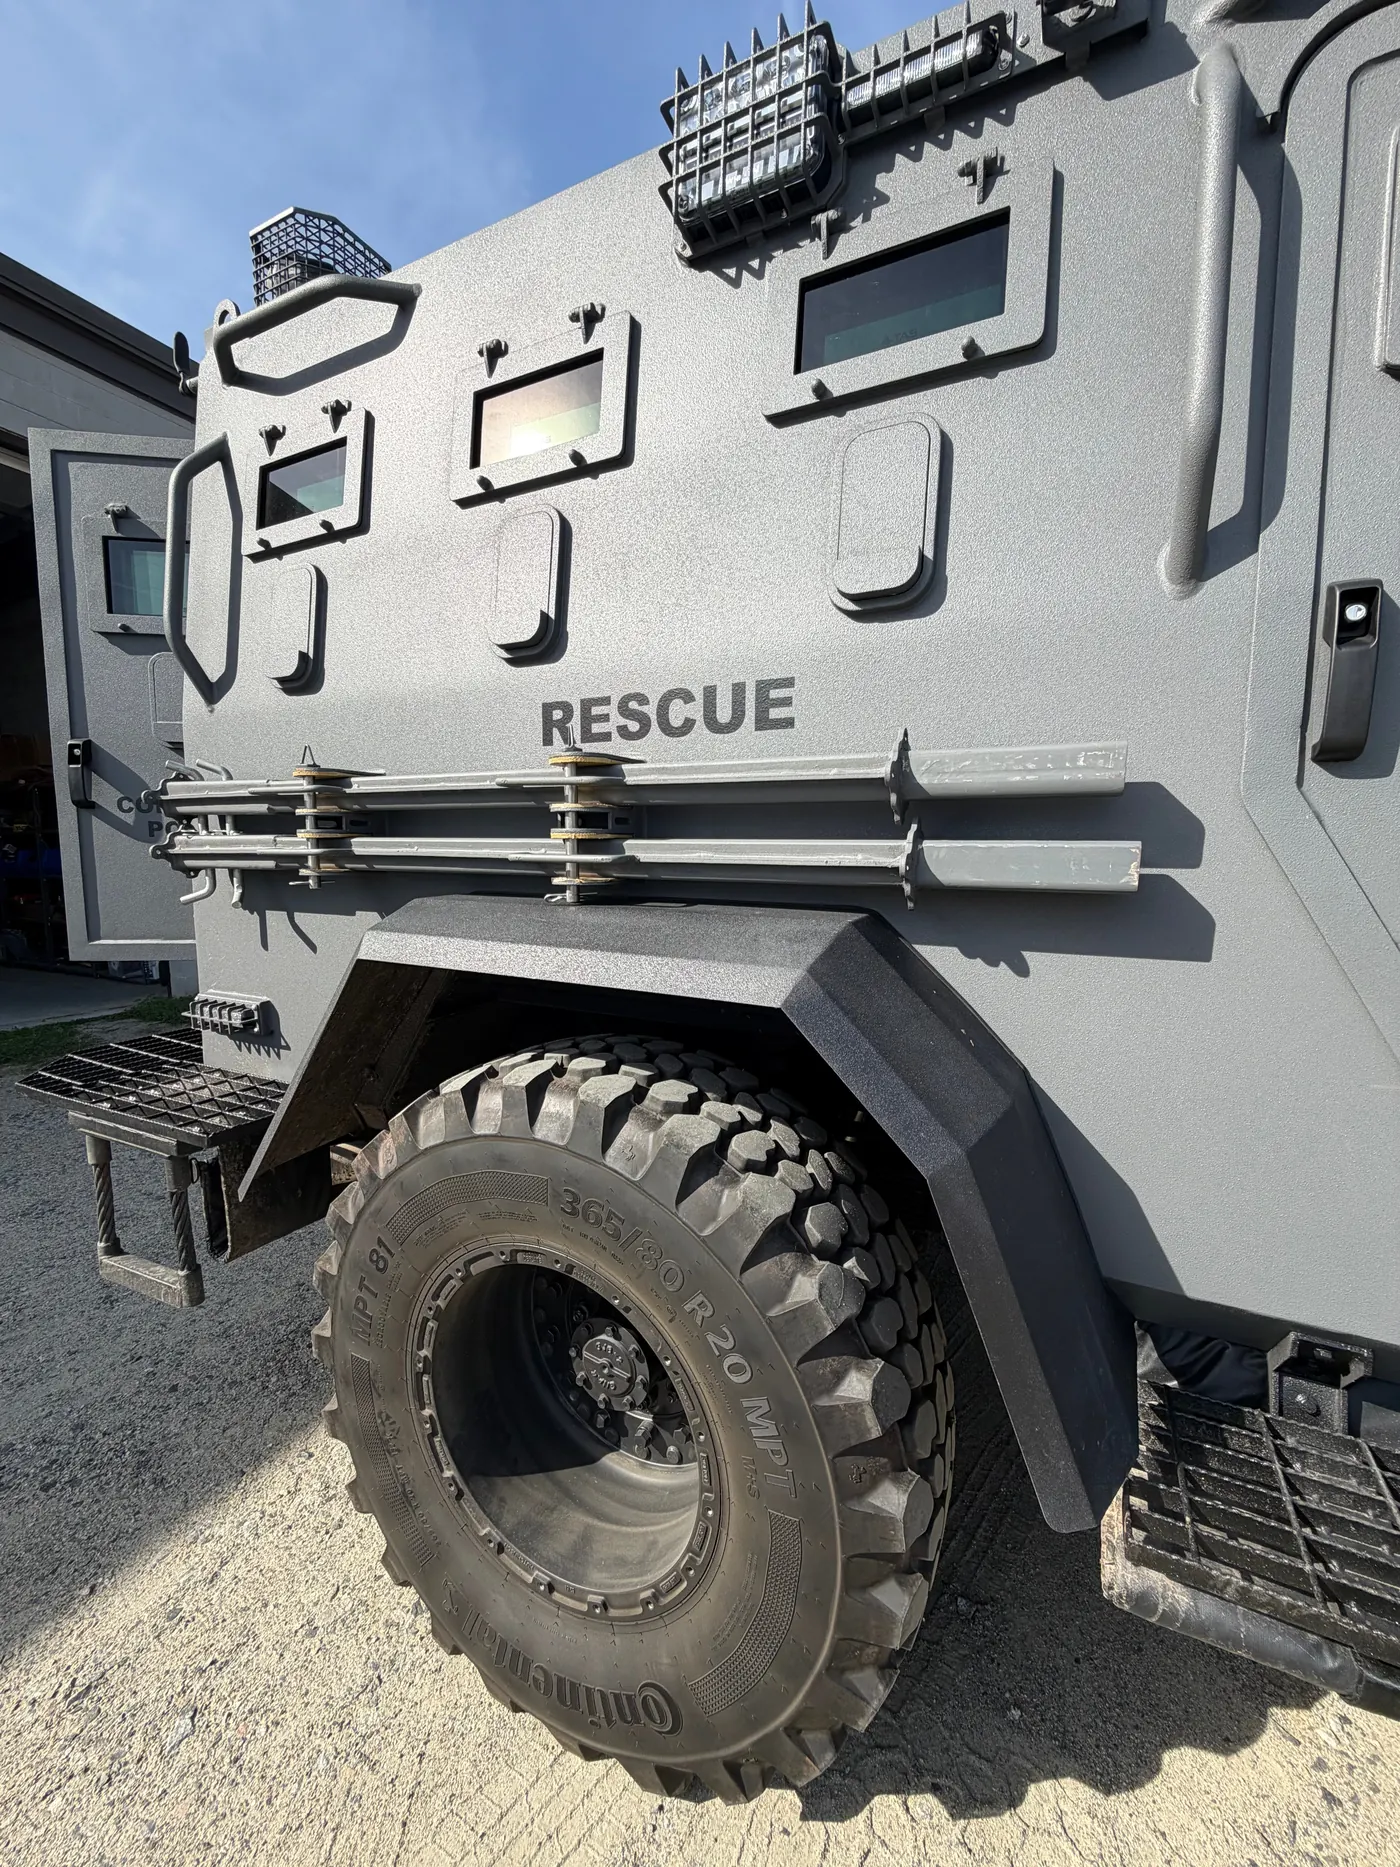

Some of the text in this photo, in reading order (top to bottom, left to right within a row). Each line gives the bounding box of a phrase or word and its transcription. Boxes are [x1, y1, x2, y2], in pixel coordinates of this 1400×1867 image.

[541, 676, 796, 747] RESCUE
[350, 1274, 378, 1347] MPT
[369, 1235, 395, 1275] 81
[560, 1187, 685, 1292] 365/80
[740, 1396, 797, 1499] MPT
[461, 1608, 684, 1737] Continental
